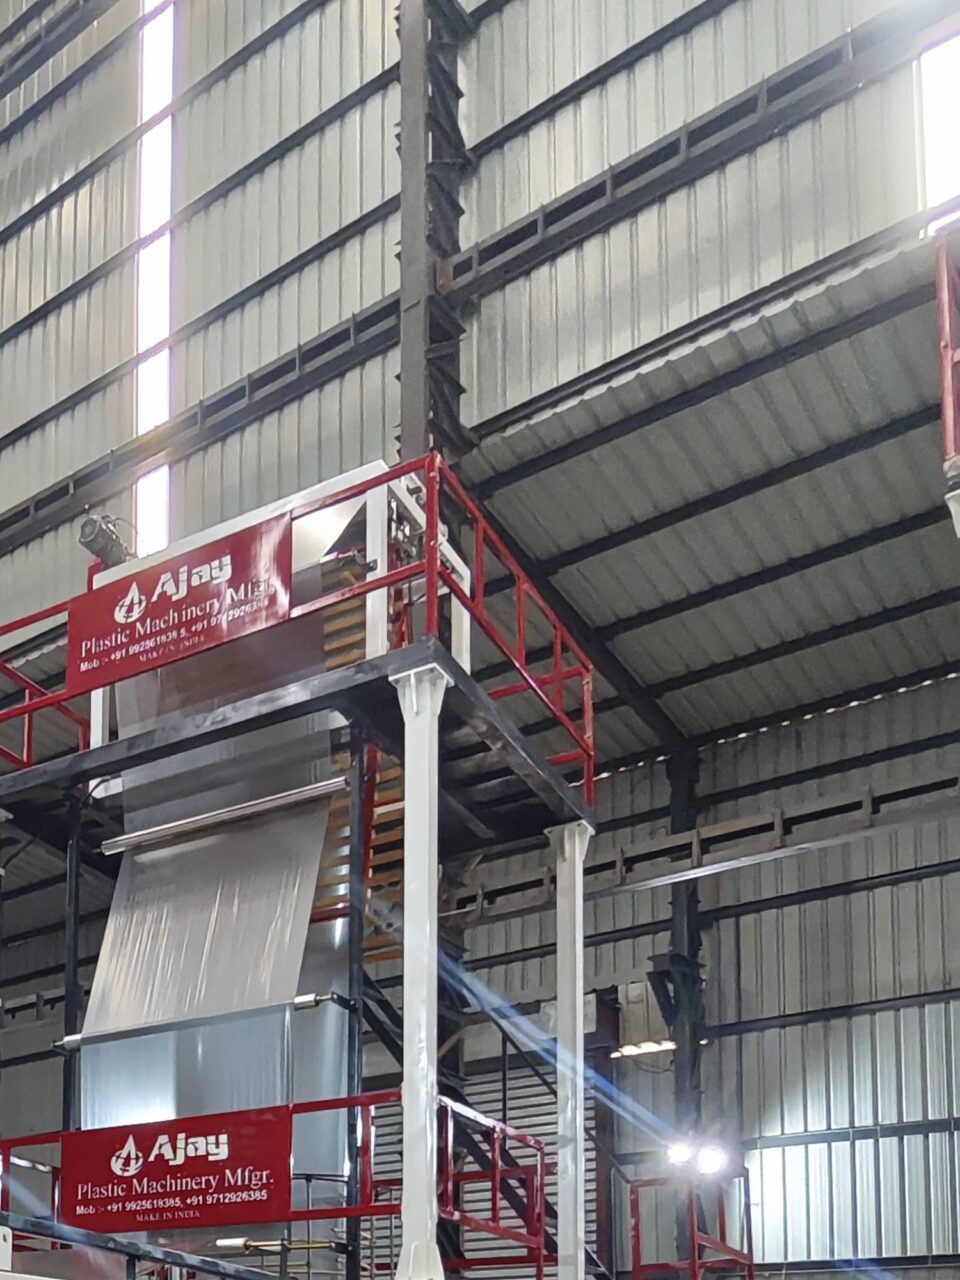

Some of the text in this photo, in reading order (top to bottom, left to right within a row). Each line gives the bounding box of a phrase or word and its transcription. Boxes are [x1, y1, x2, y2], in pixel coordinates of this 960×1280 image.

[151, 554, 232, 602] Ajay
[81, 628, 130, 658] Plastic
[135, 598, 221, 638] Machinery
[80, 659, 100, 673] Mob
[111, 648, 127, 661] +91
[191, 619, 208, 633] +91
[147, 1132, 229, 1166] Ajay
[77, 1166, 274, 1200] Plastic Machinery Mfgr.
[76, 1205, 96, 1216] Mob
[106, 1202, 123, 1212] +91
[186, 1195, 203, 1206] +91
[206, 1189, 268, 1204] 9712926385
[136, 1209, 200, 1222] MAKE IN INDIA
